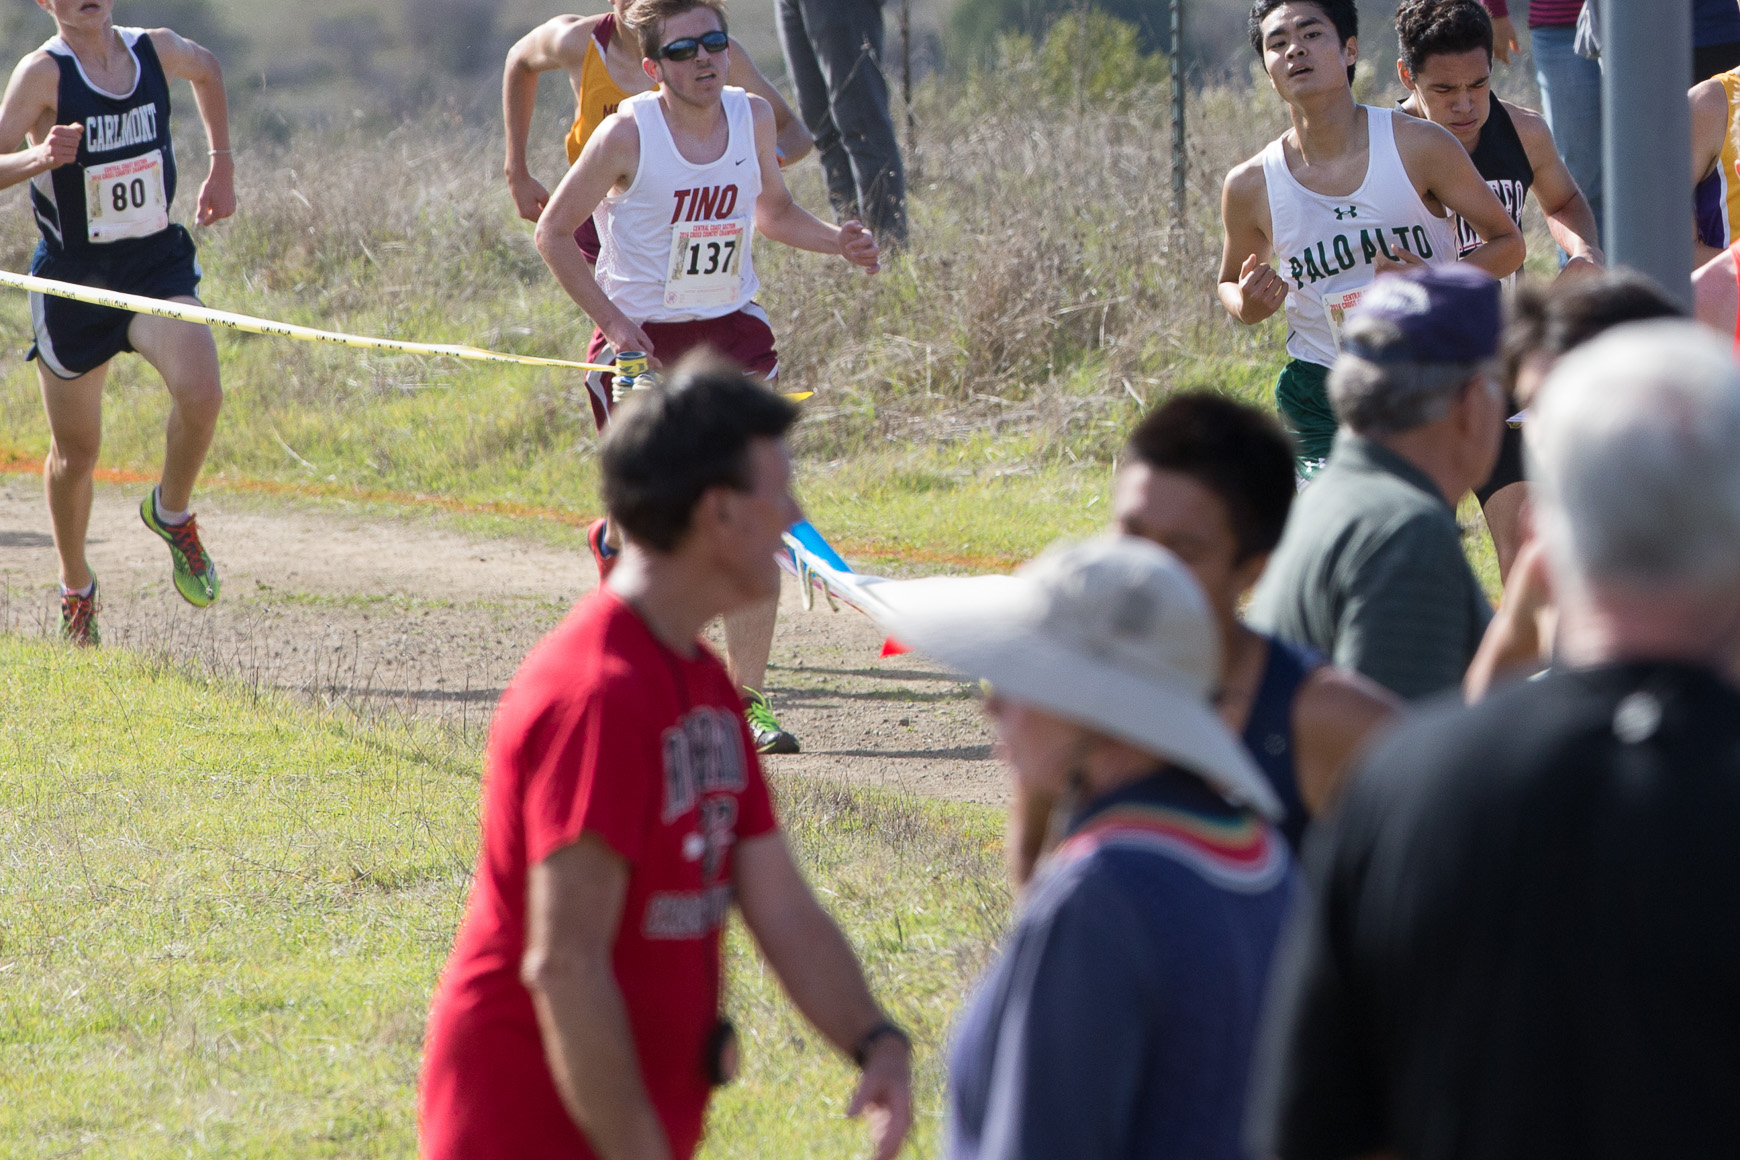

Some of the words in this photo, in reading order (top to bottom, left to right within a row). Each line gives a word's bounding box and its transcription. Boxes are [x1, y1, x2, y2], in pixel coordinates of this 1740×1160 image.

[86, 102, 157, 153] CARLMONT
[112, 178, 146, 211] 80
[671, 184, 738, 224] TINO
[686, 240, 736, 275] 137
[1289, 234, 1355, 290] PALO
[1361, 225, 1433, 264] ALTO
